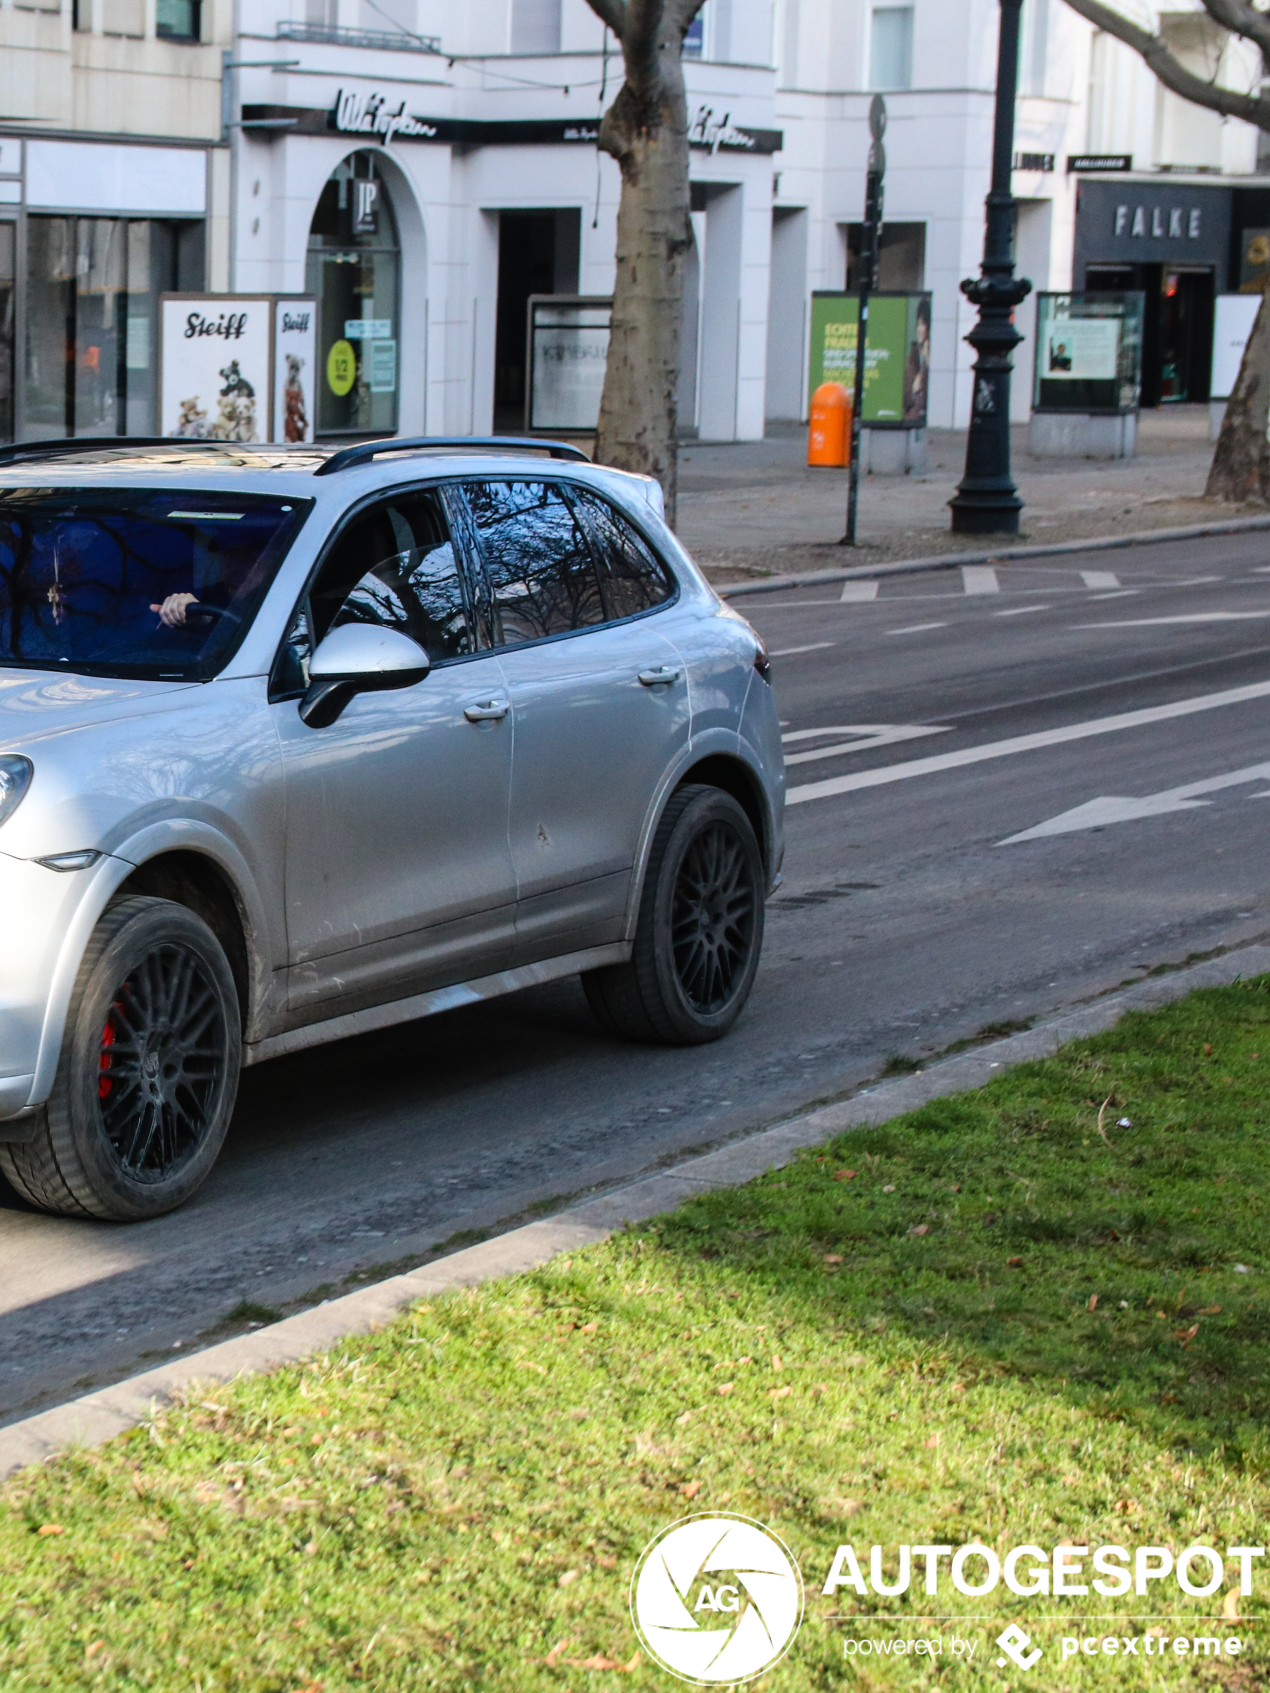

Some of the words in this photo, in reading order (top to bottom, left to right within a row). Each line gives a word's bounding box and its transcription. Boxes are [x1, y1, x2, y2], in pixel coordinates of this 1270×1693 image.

[357, 182, 378, 223] JP
[1114, 204, 1201, 238] FALKE
[183, 312, 248, 340] Steiff
[281, 312, 311, 333] Steiff
